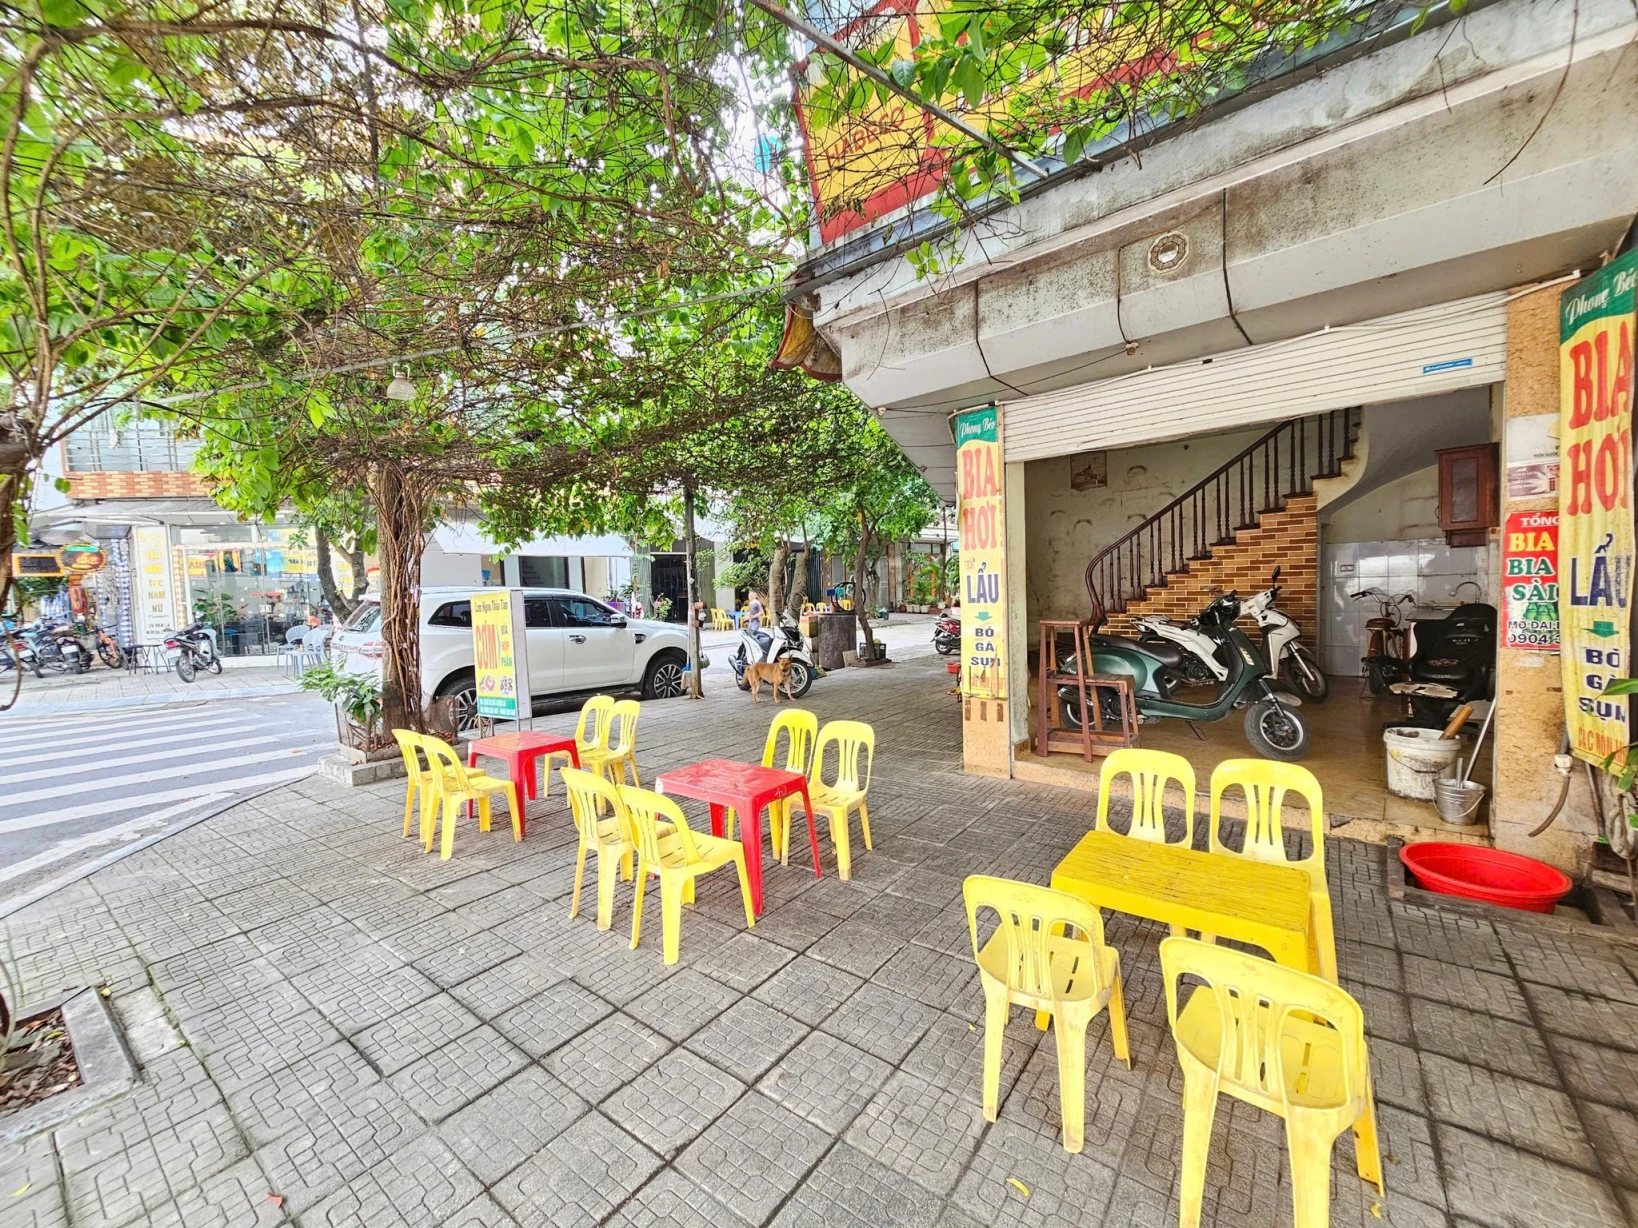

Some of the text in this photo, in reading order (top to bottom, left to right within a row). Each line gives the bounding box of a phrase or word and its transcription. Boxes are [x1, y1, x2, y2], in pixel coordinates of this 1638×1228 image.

[825, 106, 905, 169] HABECO
[1565, 288, 1610, 326] Phong
[1569, 320, 1631, 430] BIA
[960, 417, 995, 438] Phong Béo
[962, 445, 997, 500] BIA
[1567, 421, 1628, 516] HƠI
[963, 500, 997, 551] HƠI
[1508, 531, 1555, 553] BIA
[966, 562, 999, 604] LẨU
[1507, 557, 1555, 576] BIA
[1570, 533, 1632, 609] LẨU
[1512, 579, 1559, 602] SÀI
[475, 620, 498, 670] CƠM
[975, 626, 994, 637] BÒ
[975, 641, 994, 652] GÀ
[1585, 648, 1620, 668] BÒ
[1579, 697, 1626, 723] SỤN
